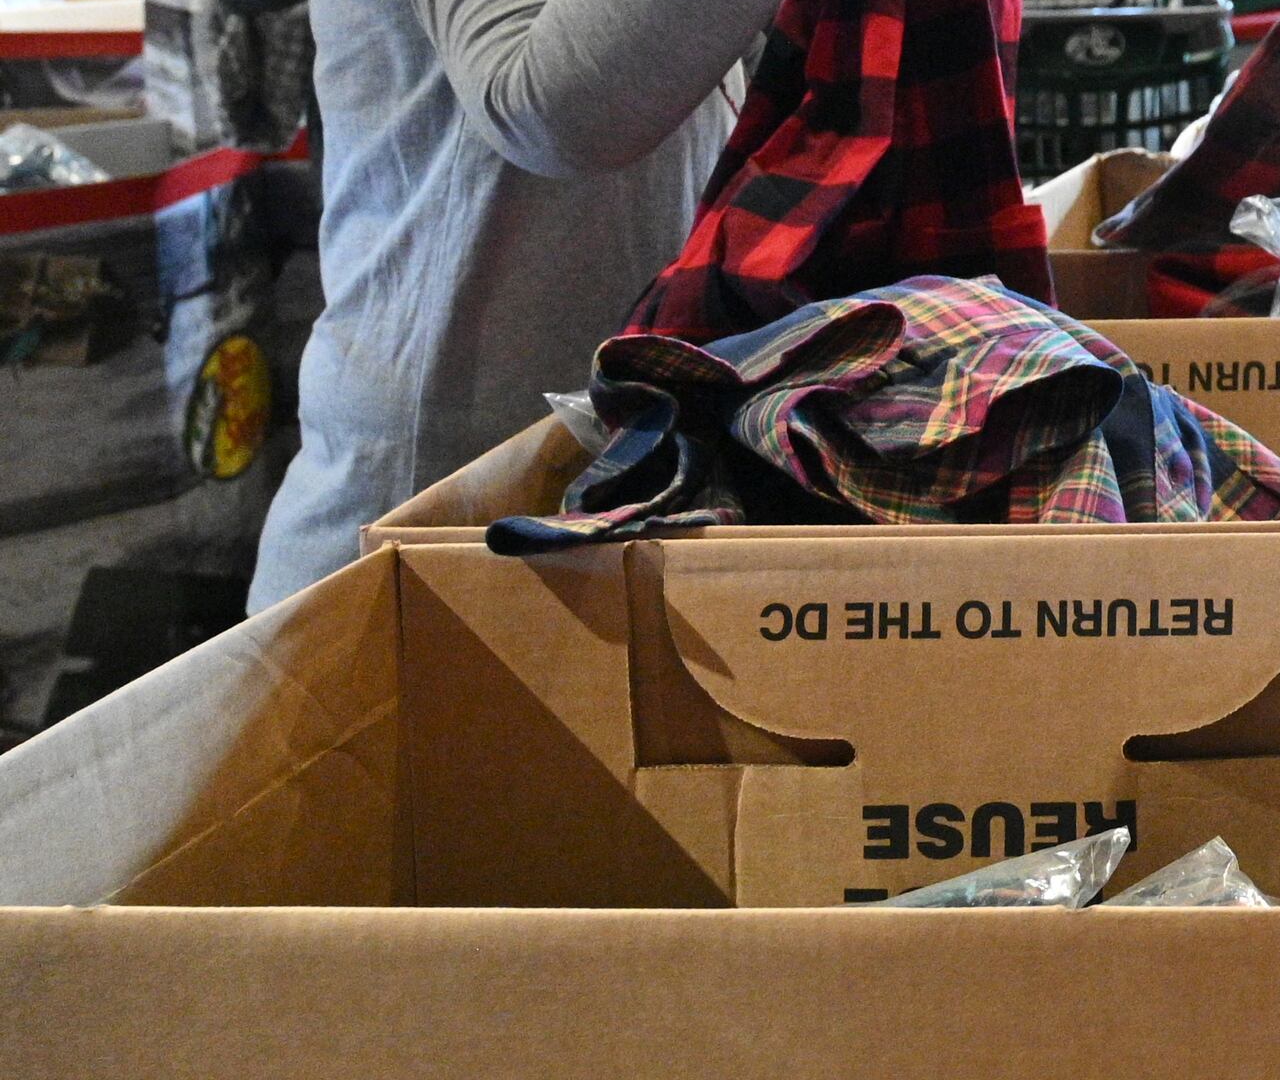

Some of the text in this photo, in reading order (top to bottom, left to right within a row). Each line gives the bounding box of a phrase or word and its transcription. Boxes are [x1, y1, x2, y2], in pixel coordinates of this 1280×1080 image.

[759, 597, 1234, 642] RETURN TO THE DC
[862, 800, 1138, 860] REUSE
